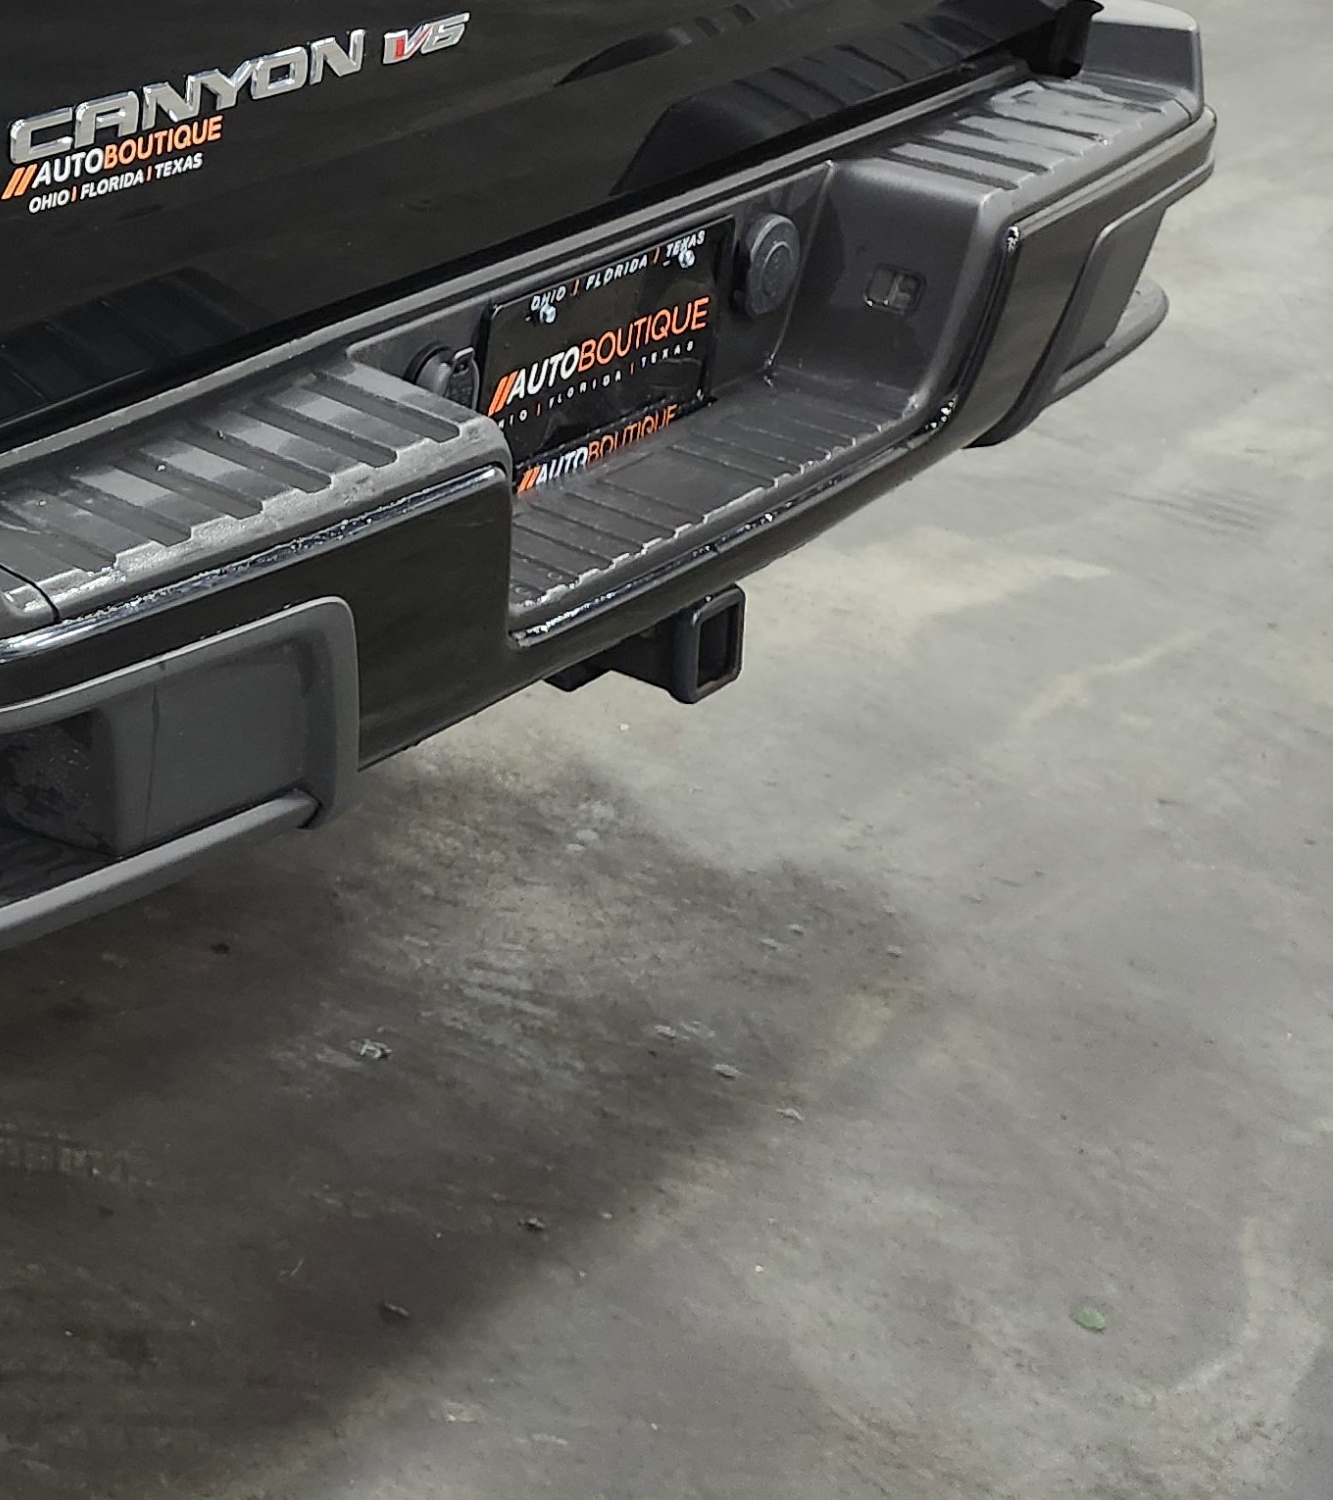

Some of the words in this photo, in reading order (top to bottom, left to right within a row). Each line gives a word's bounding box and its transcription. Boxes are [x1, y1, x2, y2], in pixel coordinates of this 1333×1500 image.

[9, 29, 366, 164] CANYON
[382, 11, 471, 65] V6
[28, 189, 70, 214] OHIO
[79, 172, 144, 201] FLORIDA
[154, 152, 204, 180] TEXAS
[30, 114, 223, 189] AUTOBOUTIQUE
[530, 285, 567, 312] OHIO
[584, 254, 648, 291] FLORIDA
[665, 229, 707, 258] TEXAS
[506, 296, 710, 405] AUTOBOUTIQUE
[548, 369, 622, 409] FLORIDA
[640, 340, 694, 368] TEXAS
